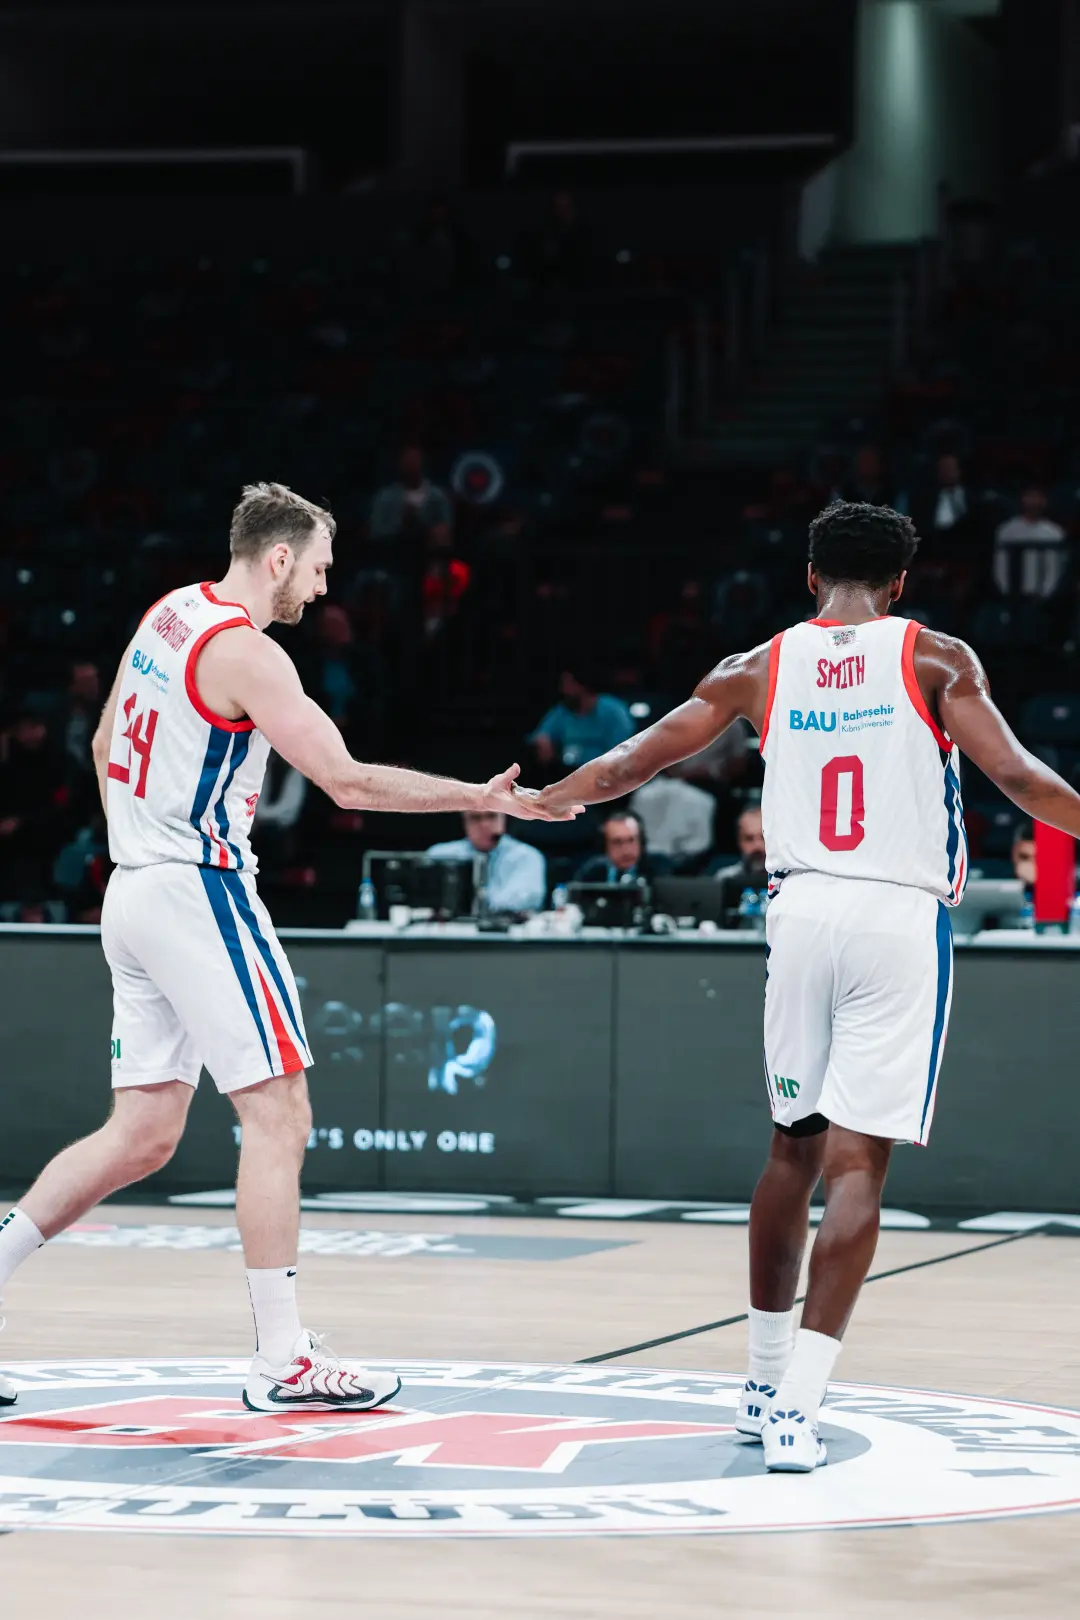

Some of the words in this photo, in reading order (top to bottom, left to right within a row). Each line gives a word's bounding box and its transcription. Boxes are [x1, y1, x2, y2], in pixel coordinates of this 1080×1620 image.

[816, 654, 865, 689] SMITH
[789, 709, 837, 732] BAU
[819, 755, 865, 852] 0
[774, 1074, 800, 1098] HD
[353, 1128, 427, 1151] ONLY
[437, 1130, 495, 1153] ONE
